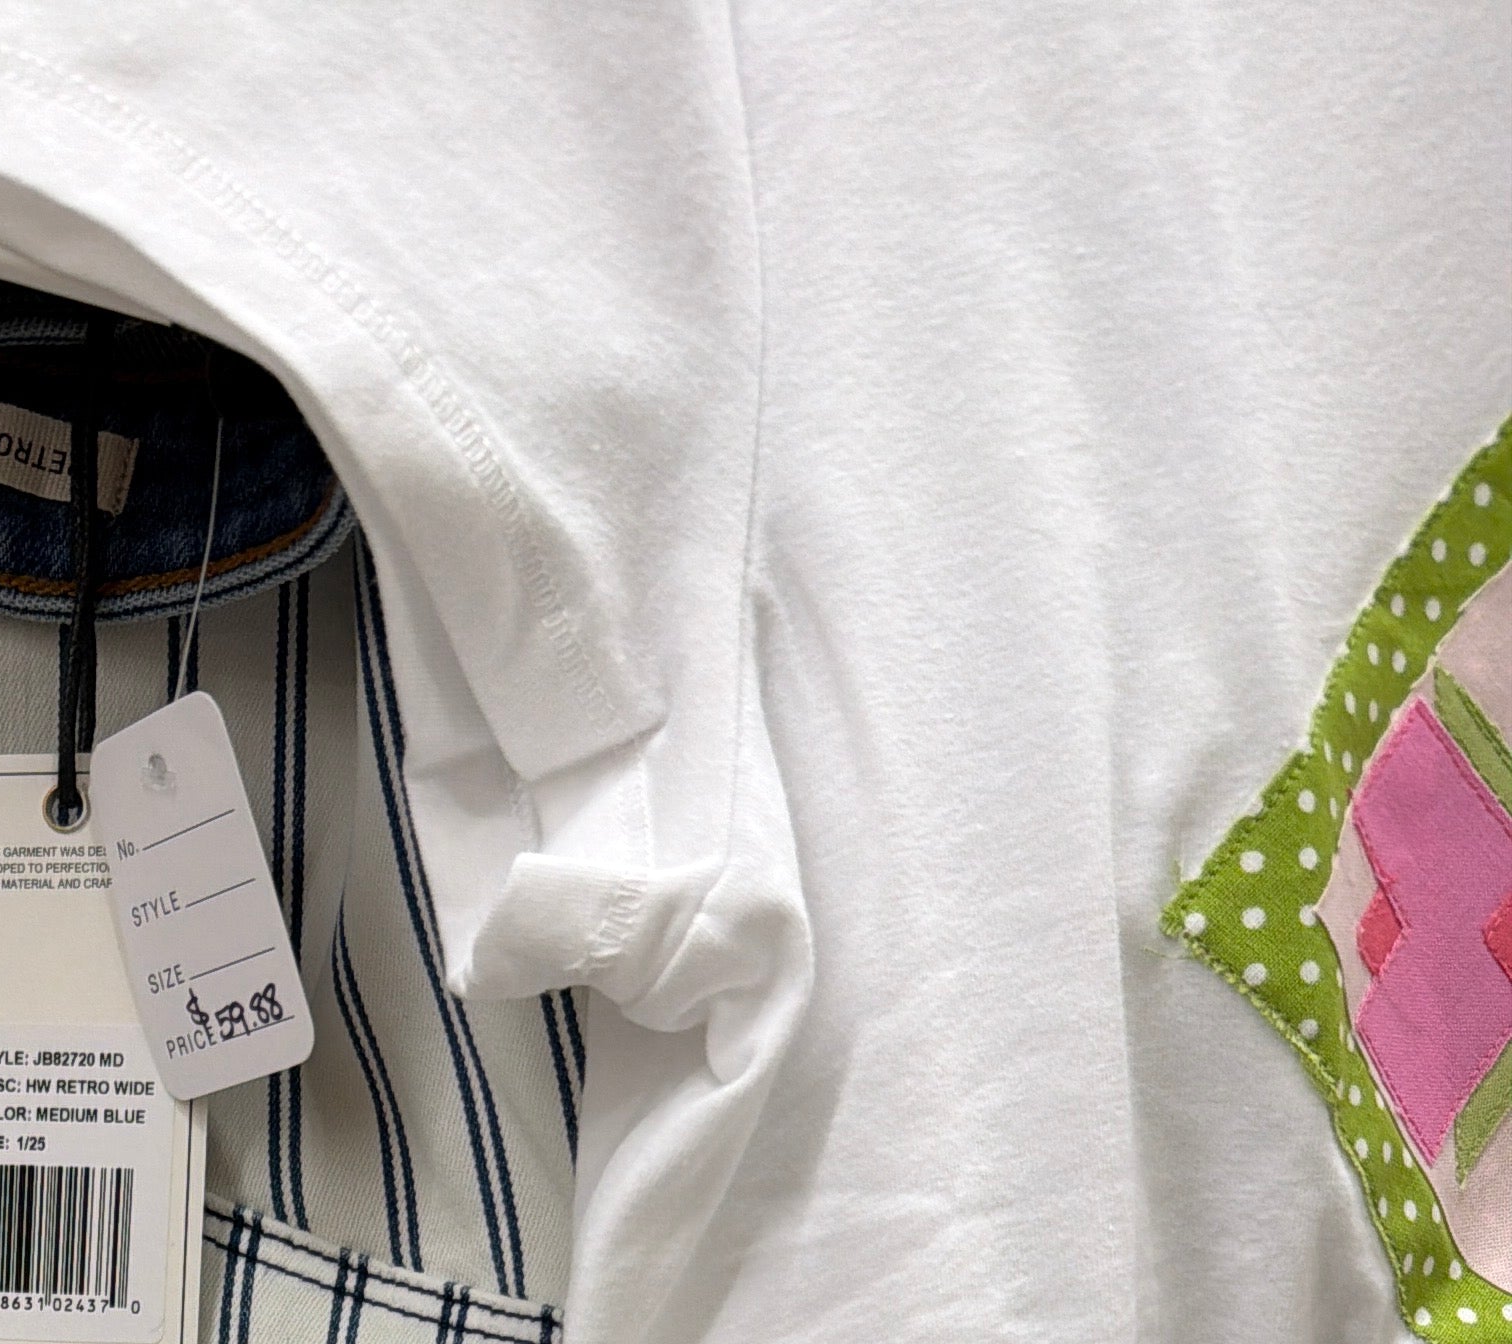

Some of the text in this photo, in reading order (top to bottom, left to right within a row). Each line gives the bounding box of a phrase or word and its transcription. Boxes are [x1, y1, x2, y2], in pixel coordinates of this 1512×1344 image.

[2, 846, 57, 858] GARMENT
[59, 846, 85, 857] WAS
[28, 863, 43, 874] TO
[1, 879, 55, 890] MATERIAL
[57, 878, 81, 889] AND
[131, 890, 181, 927] STYLE
[147, 964, 186, 994] SIZE
[186, 982, 284, 1040] $59.88
[166, 1025, 217, 1059] PRICE
[33, 1051, 96, 1067] JB82720
[99, 1053, 125, 1067] MD
[26, 1079, 52, 1093] HW
[56, 1079, 110, 1095] RETRO
[114, 1081, 155, 1096] WIDE
[36, 1107, 98, 1122] MEDIUM
[103, 1109, 146, 1124] BLUE
[16, 1136, 46, 1151] 1/25
